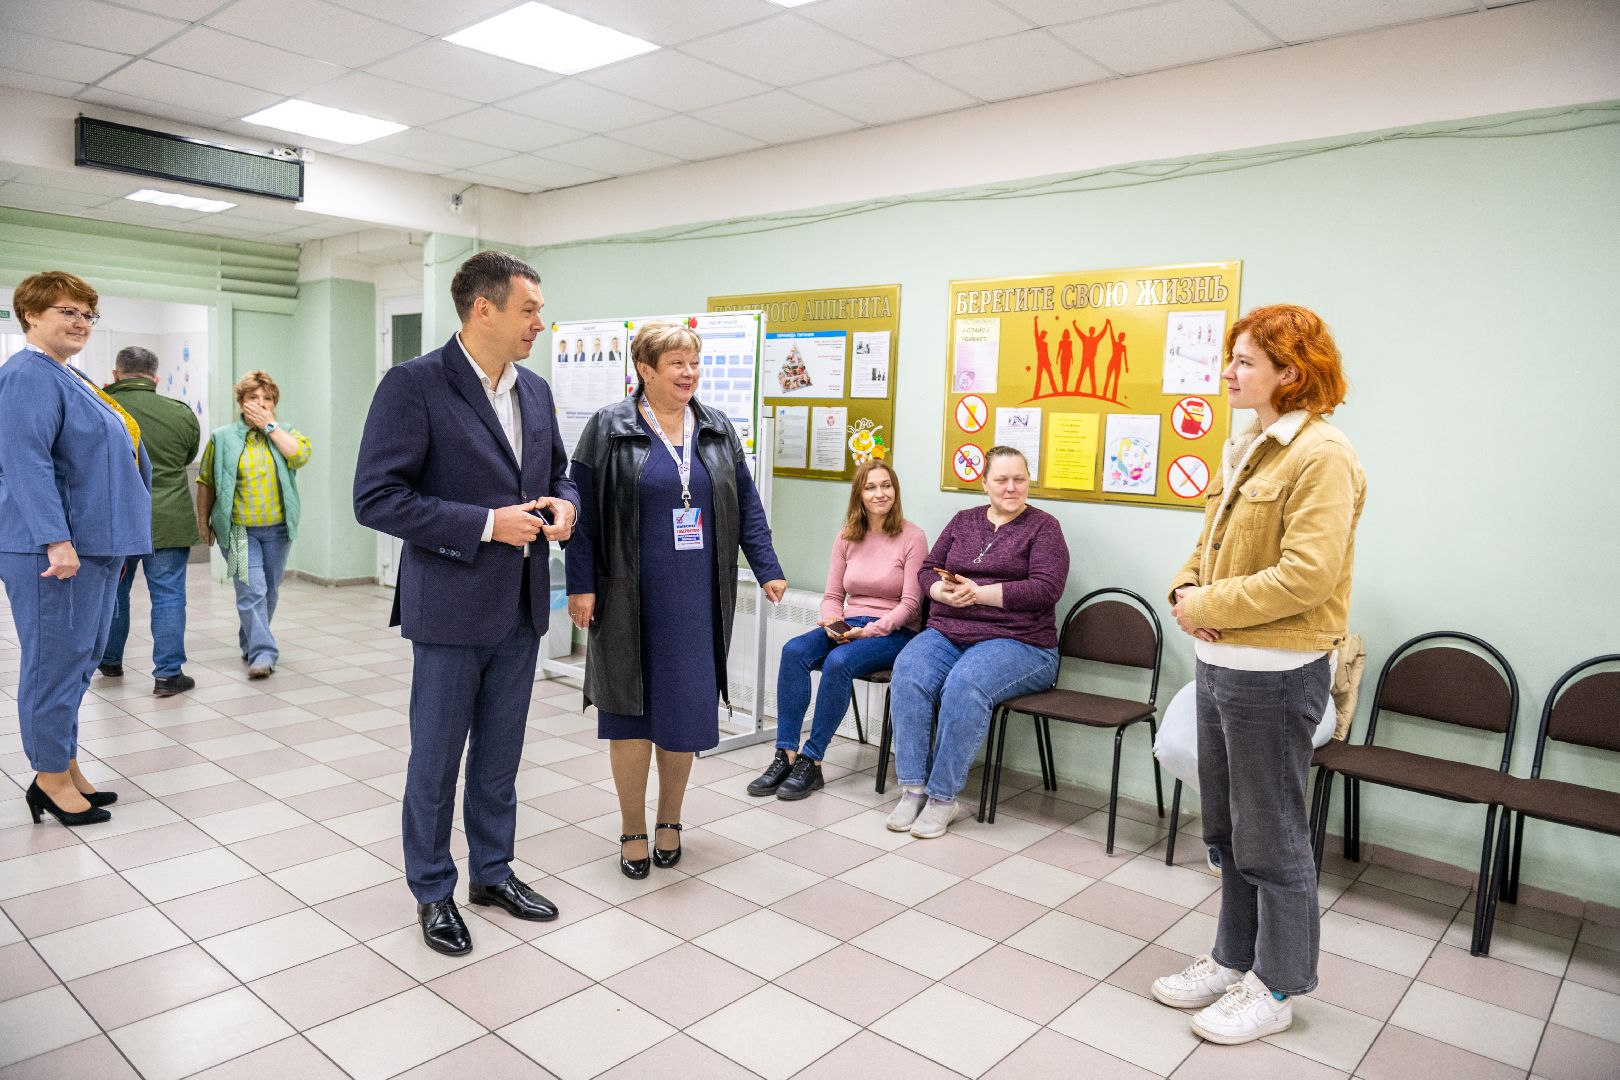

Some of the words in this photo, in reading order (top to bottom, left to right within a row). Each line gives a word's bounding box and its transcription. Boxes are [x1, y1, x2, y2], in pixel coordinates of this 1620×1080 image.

[802, 296, 893, 321] АППЕТИТА
[955, 286, 1055, 315] БЕРЕГИТЕ
[1061, 279, 1128, 310] СВОЮ
[1135, 275, 1229, 306] ЖИЗНЬ
